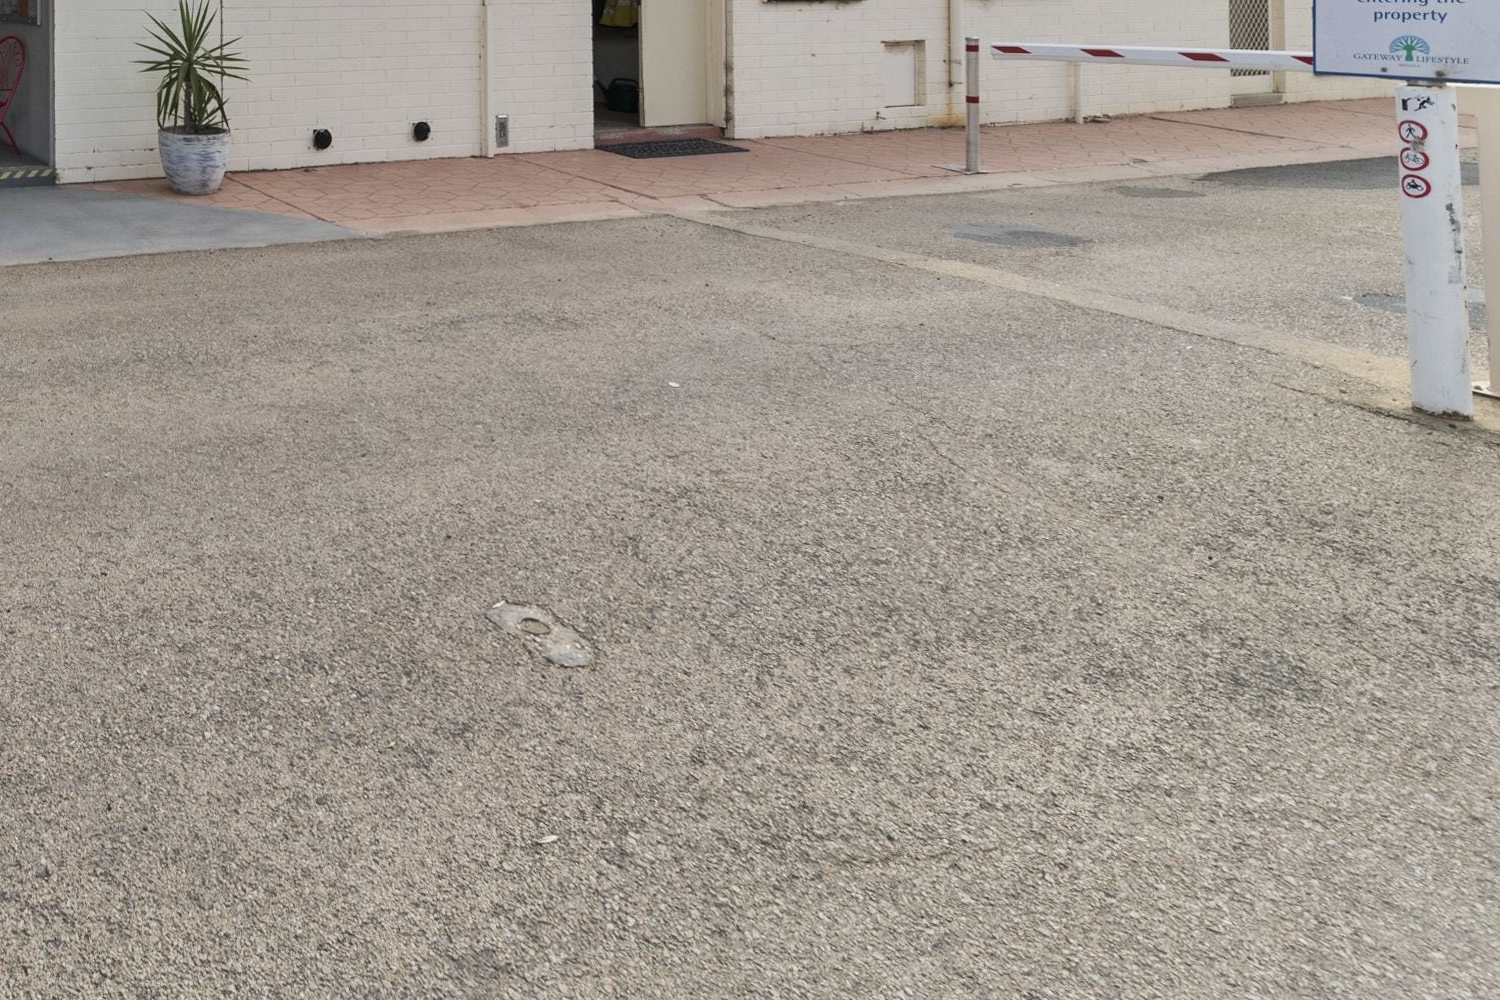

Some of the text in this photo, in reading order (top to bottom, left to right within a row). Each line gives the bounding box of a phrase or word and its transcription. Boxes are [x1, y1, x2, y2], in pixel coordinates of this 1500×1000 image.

[1373, 10, 1448, 24] property
[1353, 52, 1402, 61] GATEWAY
[1416, 55, 1469, 65] LIFESTYLE
